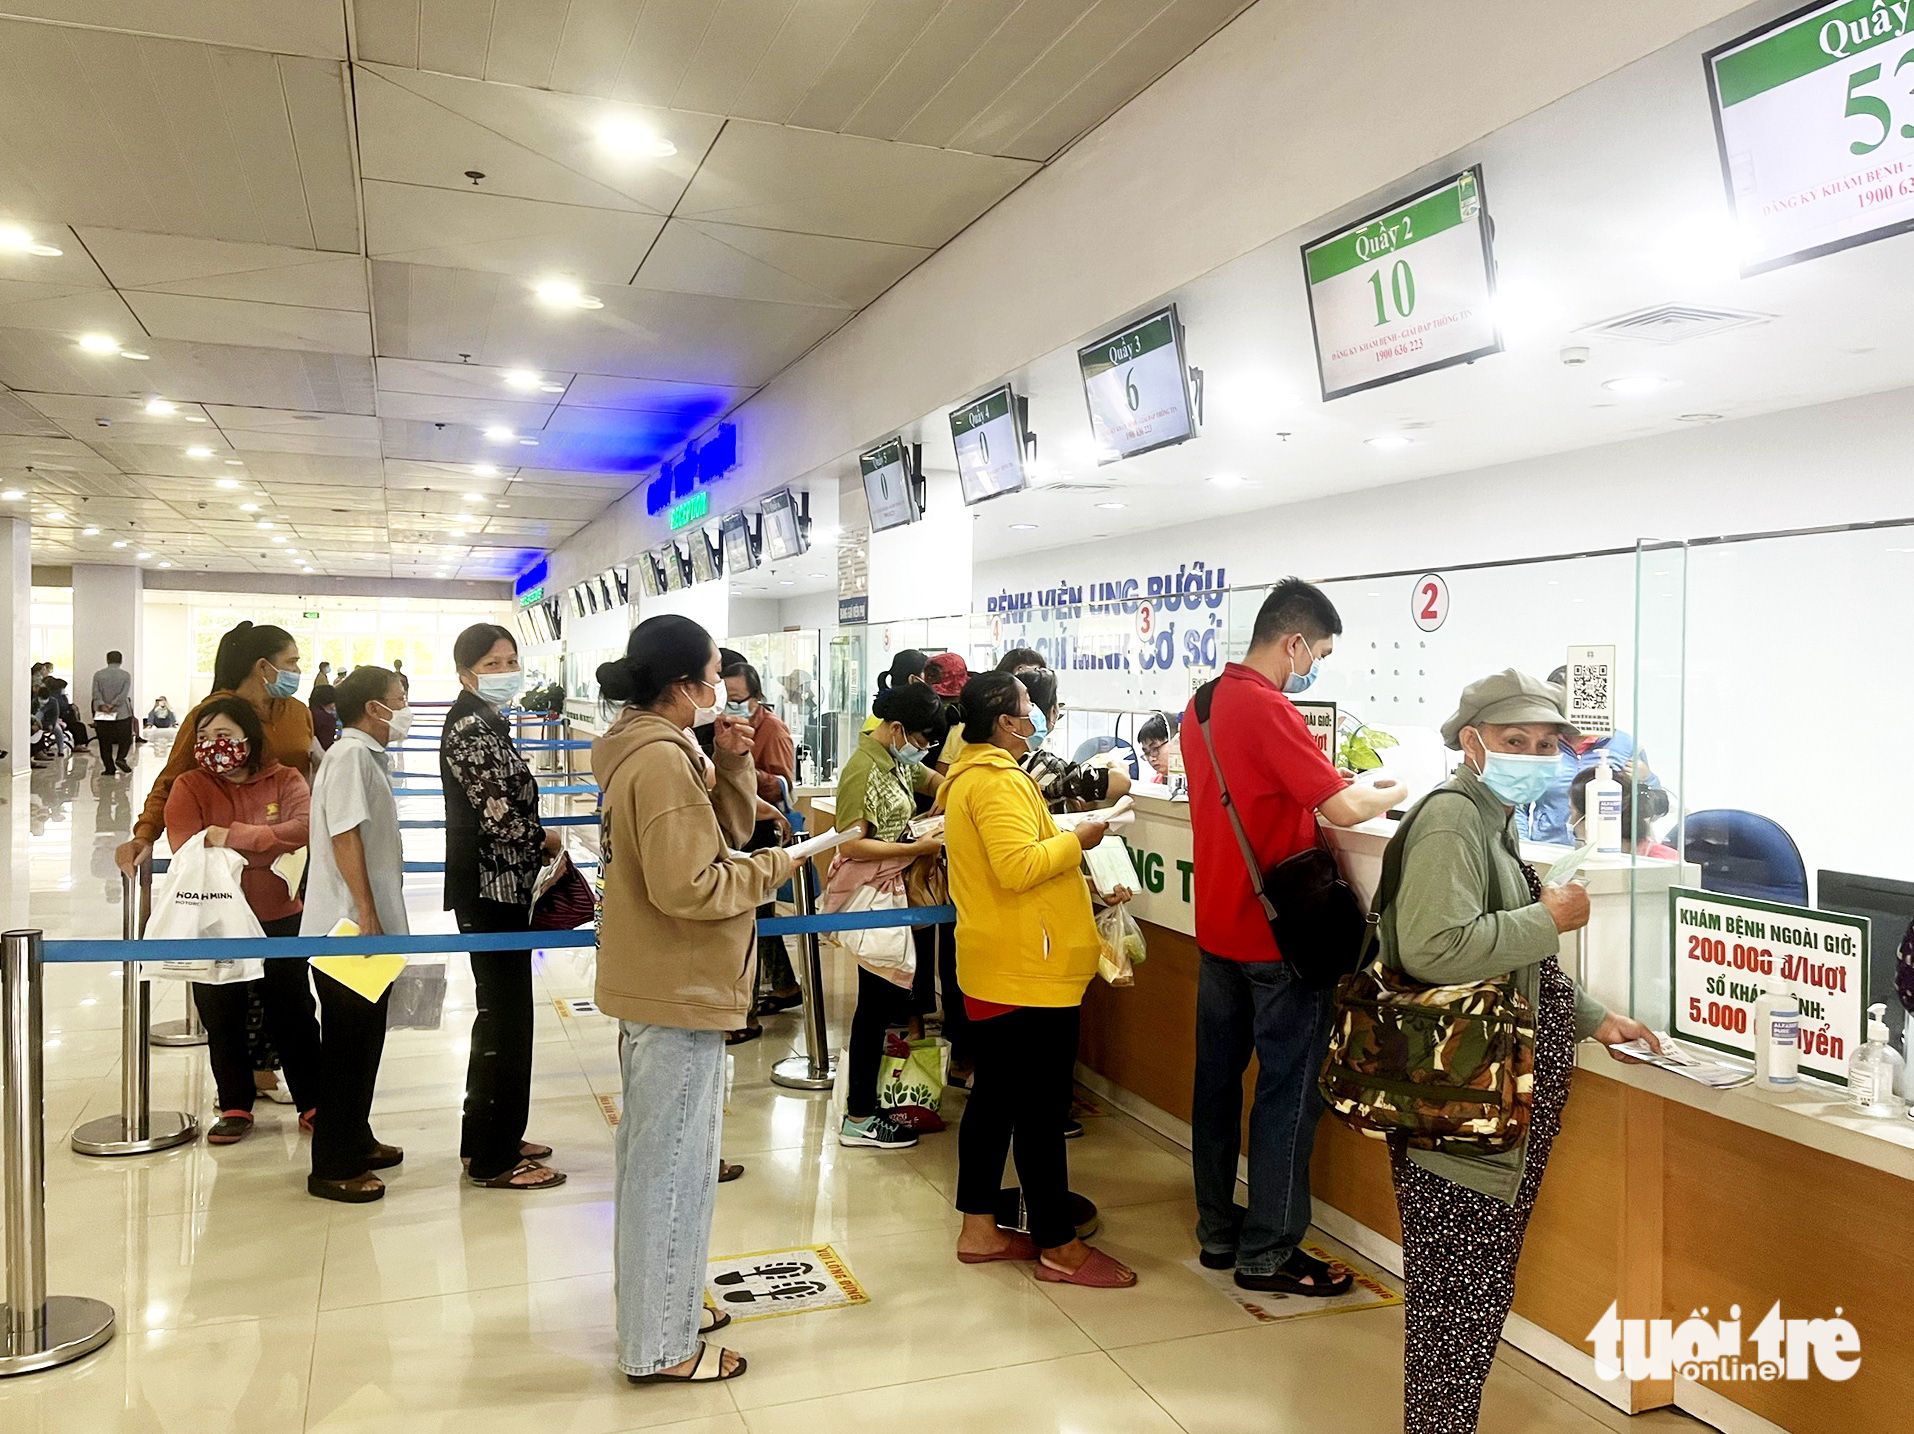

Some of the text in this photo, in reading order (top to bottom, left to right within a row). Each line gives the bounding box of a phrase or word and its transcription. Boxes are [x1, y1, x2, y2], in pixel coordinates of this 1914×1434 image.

[1822, 175, 1863, 197] KHÁM
[1867, 161, 1904, 183] BỆNH
[1858, 184, 1893, 208] 1900
[1355, 216, 1414, 262] Quầy 2
[1367, 259, 1416, 327] 10
[1109, 335, 1142, 365] Quầy 3
[1375, 338, 1424, 362] 1900 636 223
[1126, 366, 1140, 412] 6
[985, 404, 990, 419] 4
[979, 430, 990, 465] 0
[1420, 583, 1438, 619] 2
[1141, 607, 1150, 633] 3
[1680, 907, 1857, 957] KHÁM BỆNH NGOÀI GIỜ:
[1688, 934, 1773, 975] 200.000
[1706, 973, 1727, 997] SỔ
[1689, 997, 1747, 1034] 5.000
[816, 1249, 833, 1260] VUI
[825, 1260, 848, 1279] LÒNG
